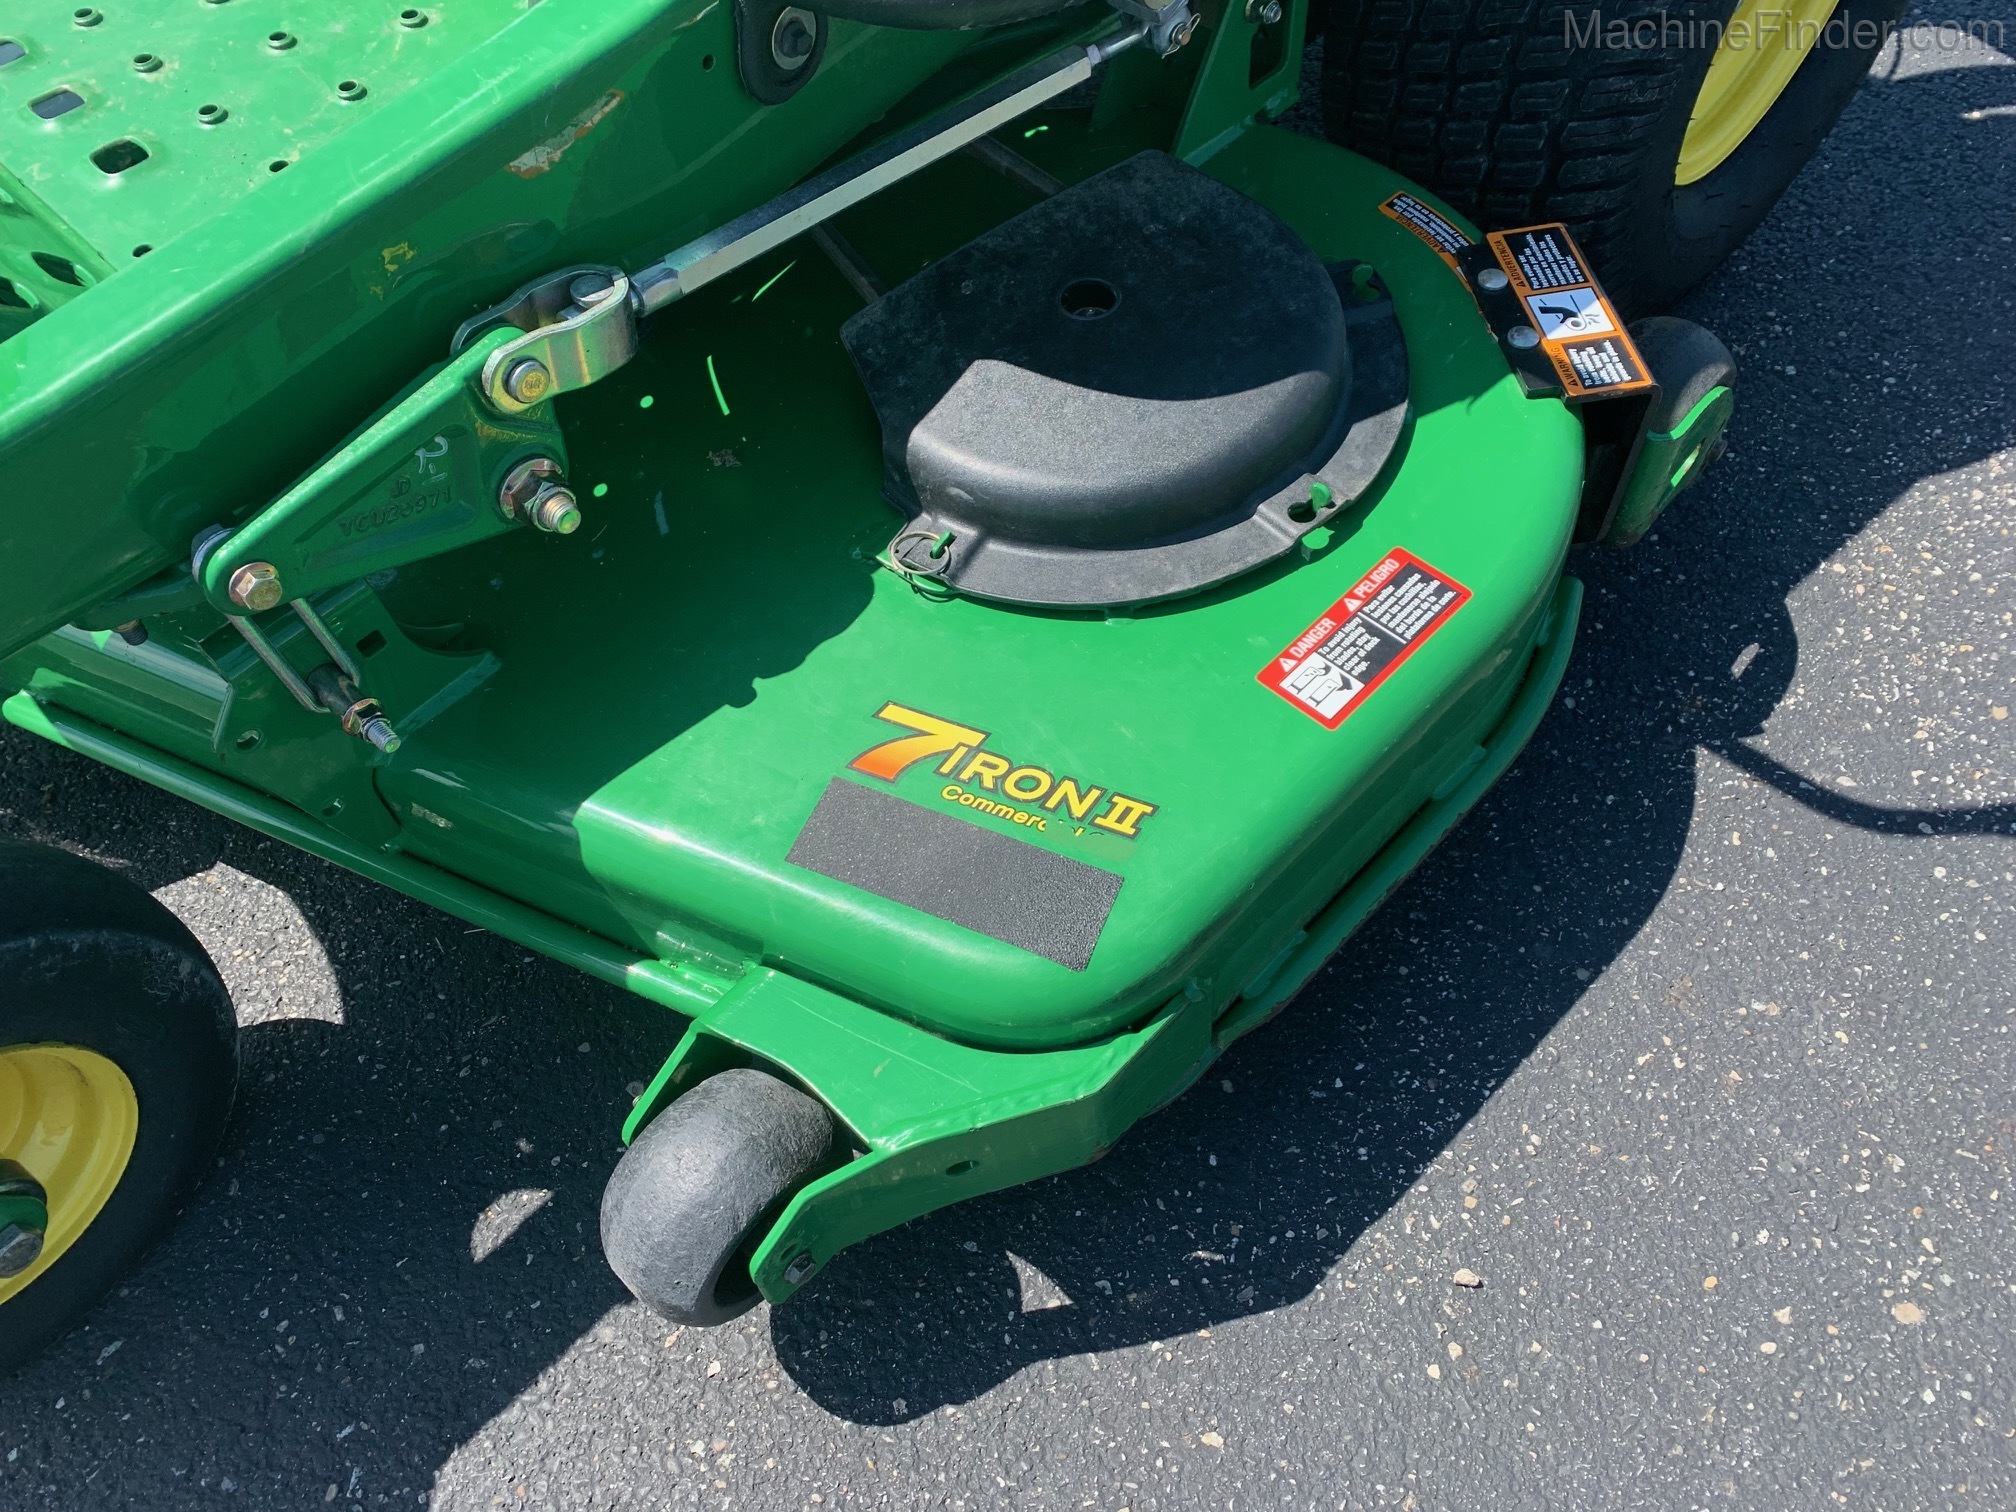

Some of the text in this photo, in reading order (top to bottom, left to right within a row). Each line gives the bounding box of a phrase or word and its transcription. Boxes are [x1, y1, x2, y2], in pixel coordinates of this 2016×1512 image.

[1494, 240, 1521, 280] ADVERTENCIA
[1528, 256, 1538, 264] por
[1539, 241, 1566, 284] mantener todos los
[1545, 234, 1564, 259] protectores
[1566, 255, 1577, 268] lugar.
[1523, 263, 1534, 276] evitar
[1530, 277, 1540, 288] Para
[1533, 264, 1549, 287] lesionado
[1544, 268, 1558, 286] correas
[1561, 264, 1575, 283] escudos
[1551, 347, 1574, 381] WARNING
[1575, 364, 1589, 378] avoid
[1354, 559, 1399, 597] PELIGRO
[1362, 585, 1395, 613] Para evitar
[1370, 573, 1421, 618] lesiones causadas
[1379, 582, 1426, 624] por las cuchillas,
[1388, 598, 1421, 628] mantenerse
[1418, 580, 1440, 599] alejado
[1395, 622, 1408, 633] del
[1403, 608, 1423, 624] borde
[1420, 601, 1430, 610] de
[1404, 611, 1434, 639] plataforma
[1431, 604, 1441, 612] de
[1438, 591, 1456, 605] corte.
[1290, 618, 1335, 657] DANGER
[1318, 617, 1362, 654] To avoid injury
[1326, 626, 1365, 660] from rotating
[1334, 631, 1372, 665] blades, stay
[1343, 637, 1380, 670] clear of deck
[1351, 661, 1370, 676] edge.
[846, 700, 991, 783] 7
